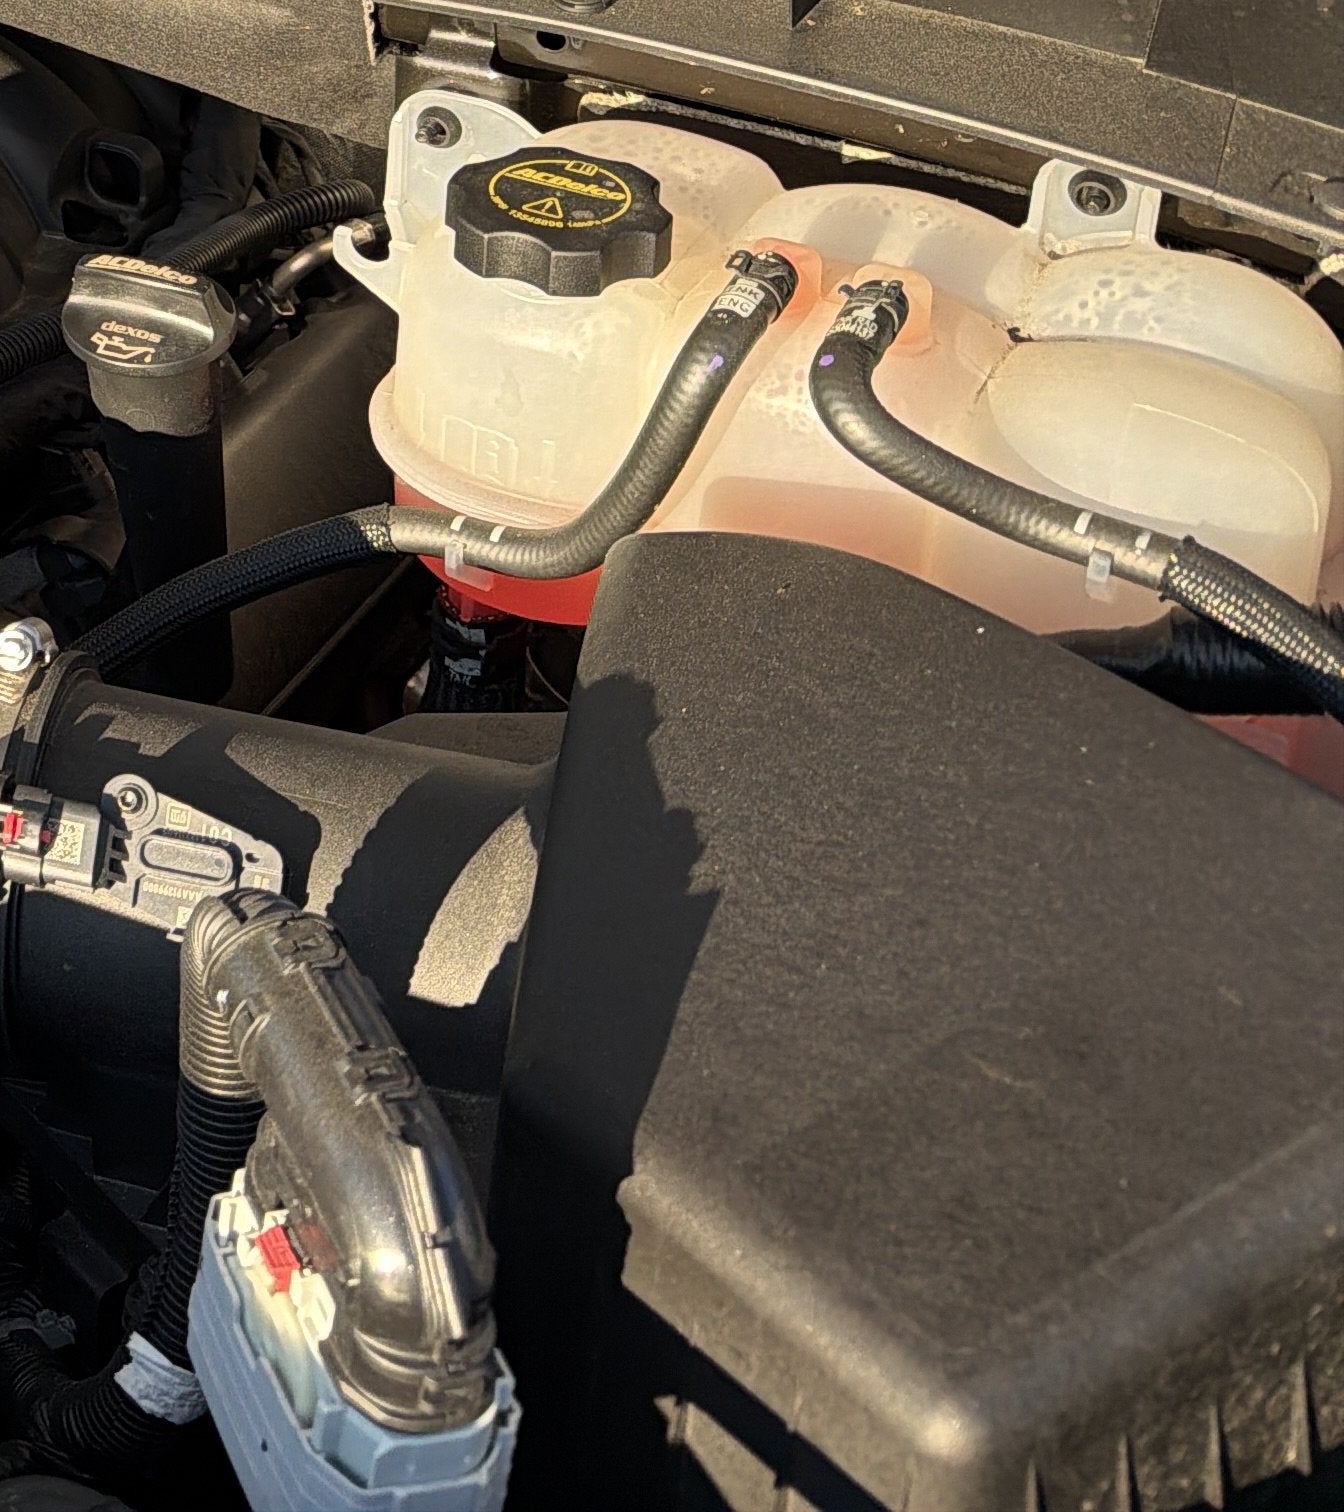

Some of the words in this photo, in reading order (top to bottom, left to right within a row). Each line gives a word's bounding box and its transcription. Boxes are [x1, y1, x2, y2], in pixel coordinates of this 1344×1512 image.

[509, 168, 626, 201] ACDelco
[85, 254, 198, 285] ACDelco
[718, 297, 752, 313] ENG
[100, 320, 163, 344] dexos
